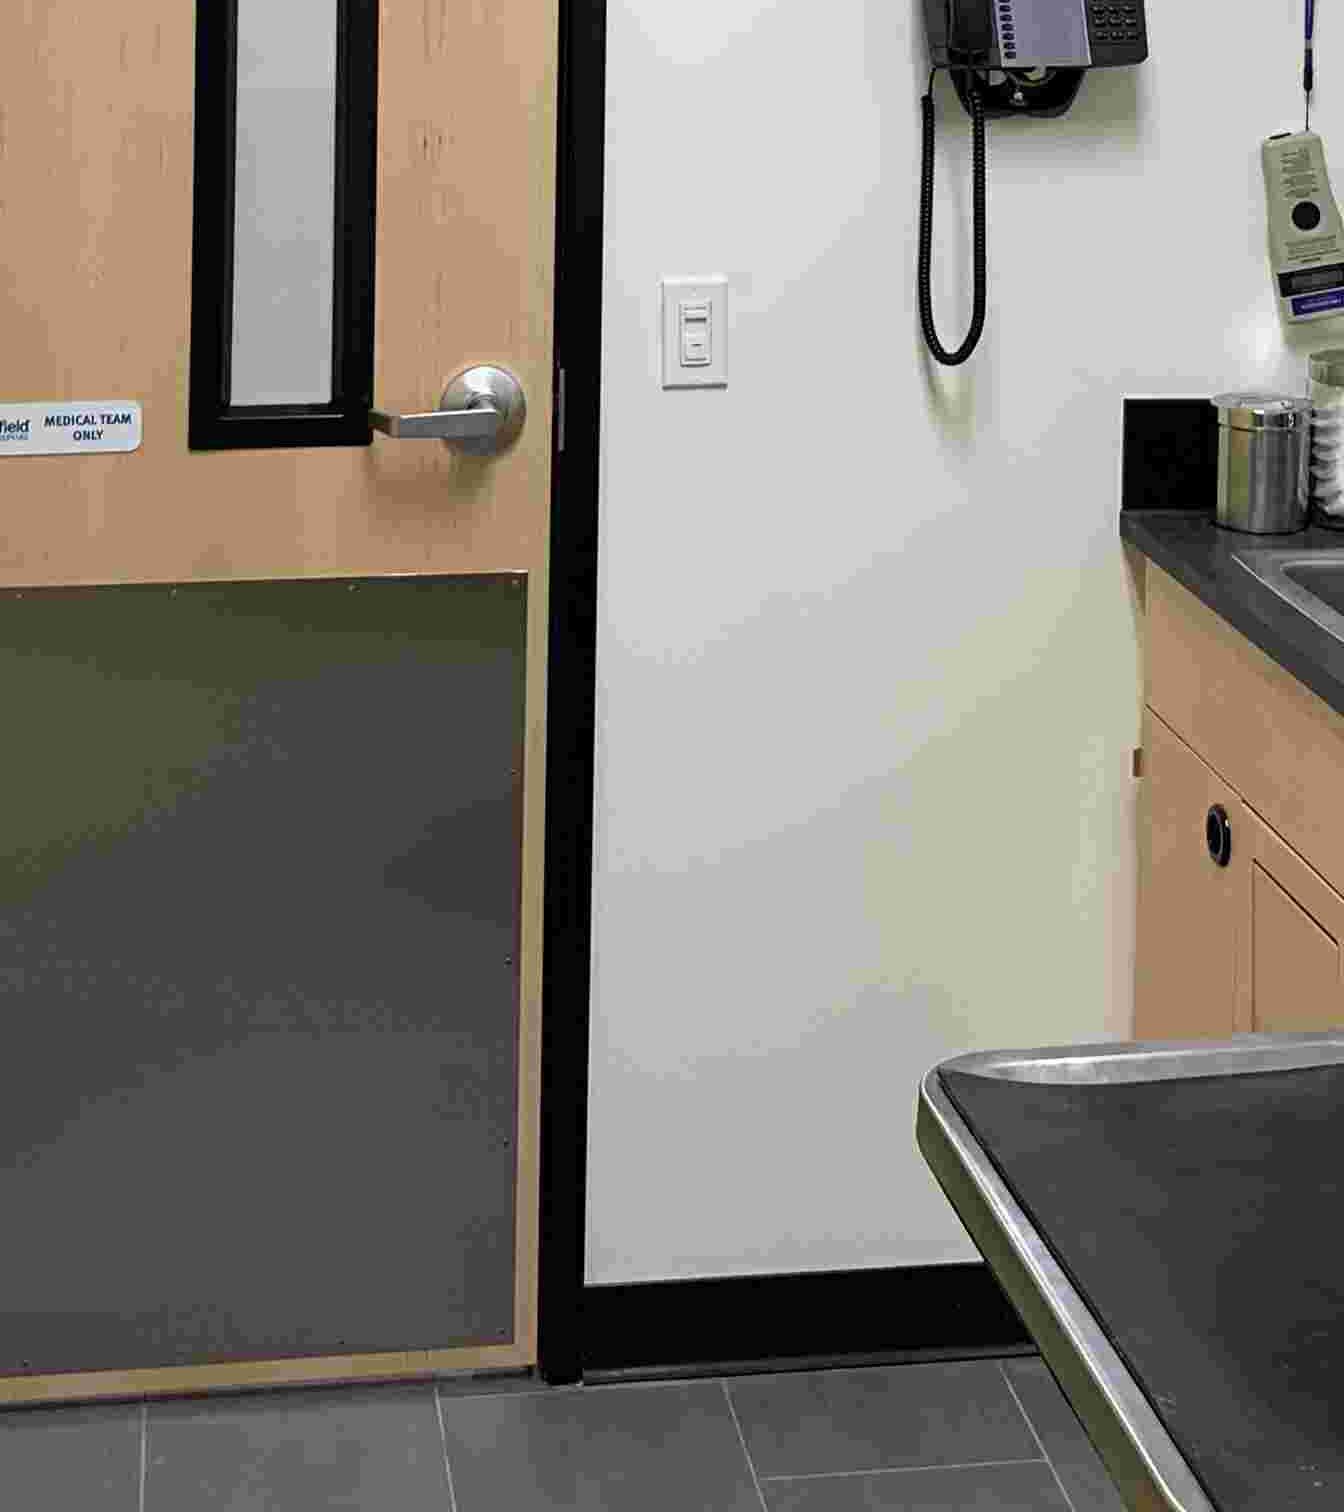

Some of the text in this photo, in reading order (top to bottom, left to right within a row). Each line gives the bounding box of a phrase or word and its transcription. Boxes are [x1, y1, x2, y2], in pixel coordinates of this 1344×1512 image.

[44, 413, 132, 428] MEDICAL TEAM
[73, 430, 104, 442] ONLY
